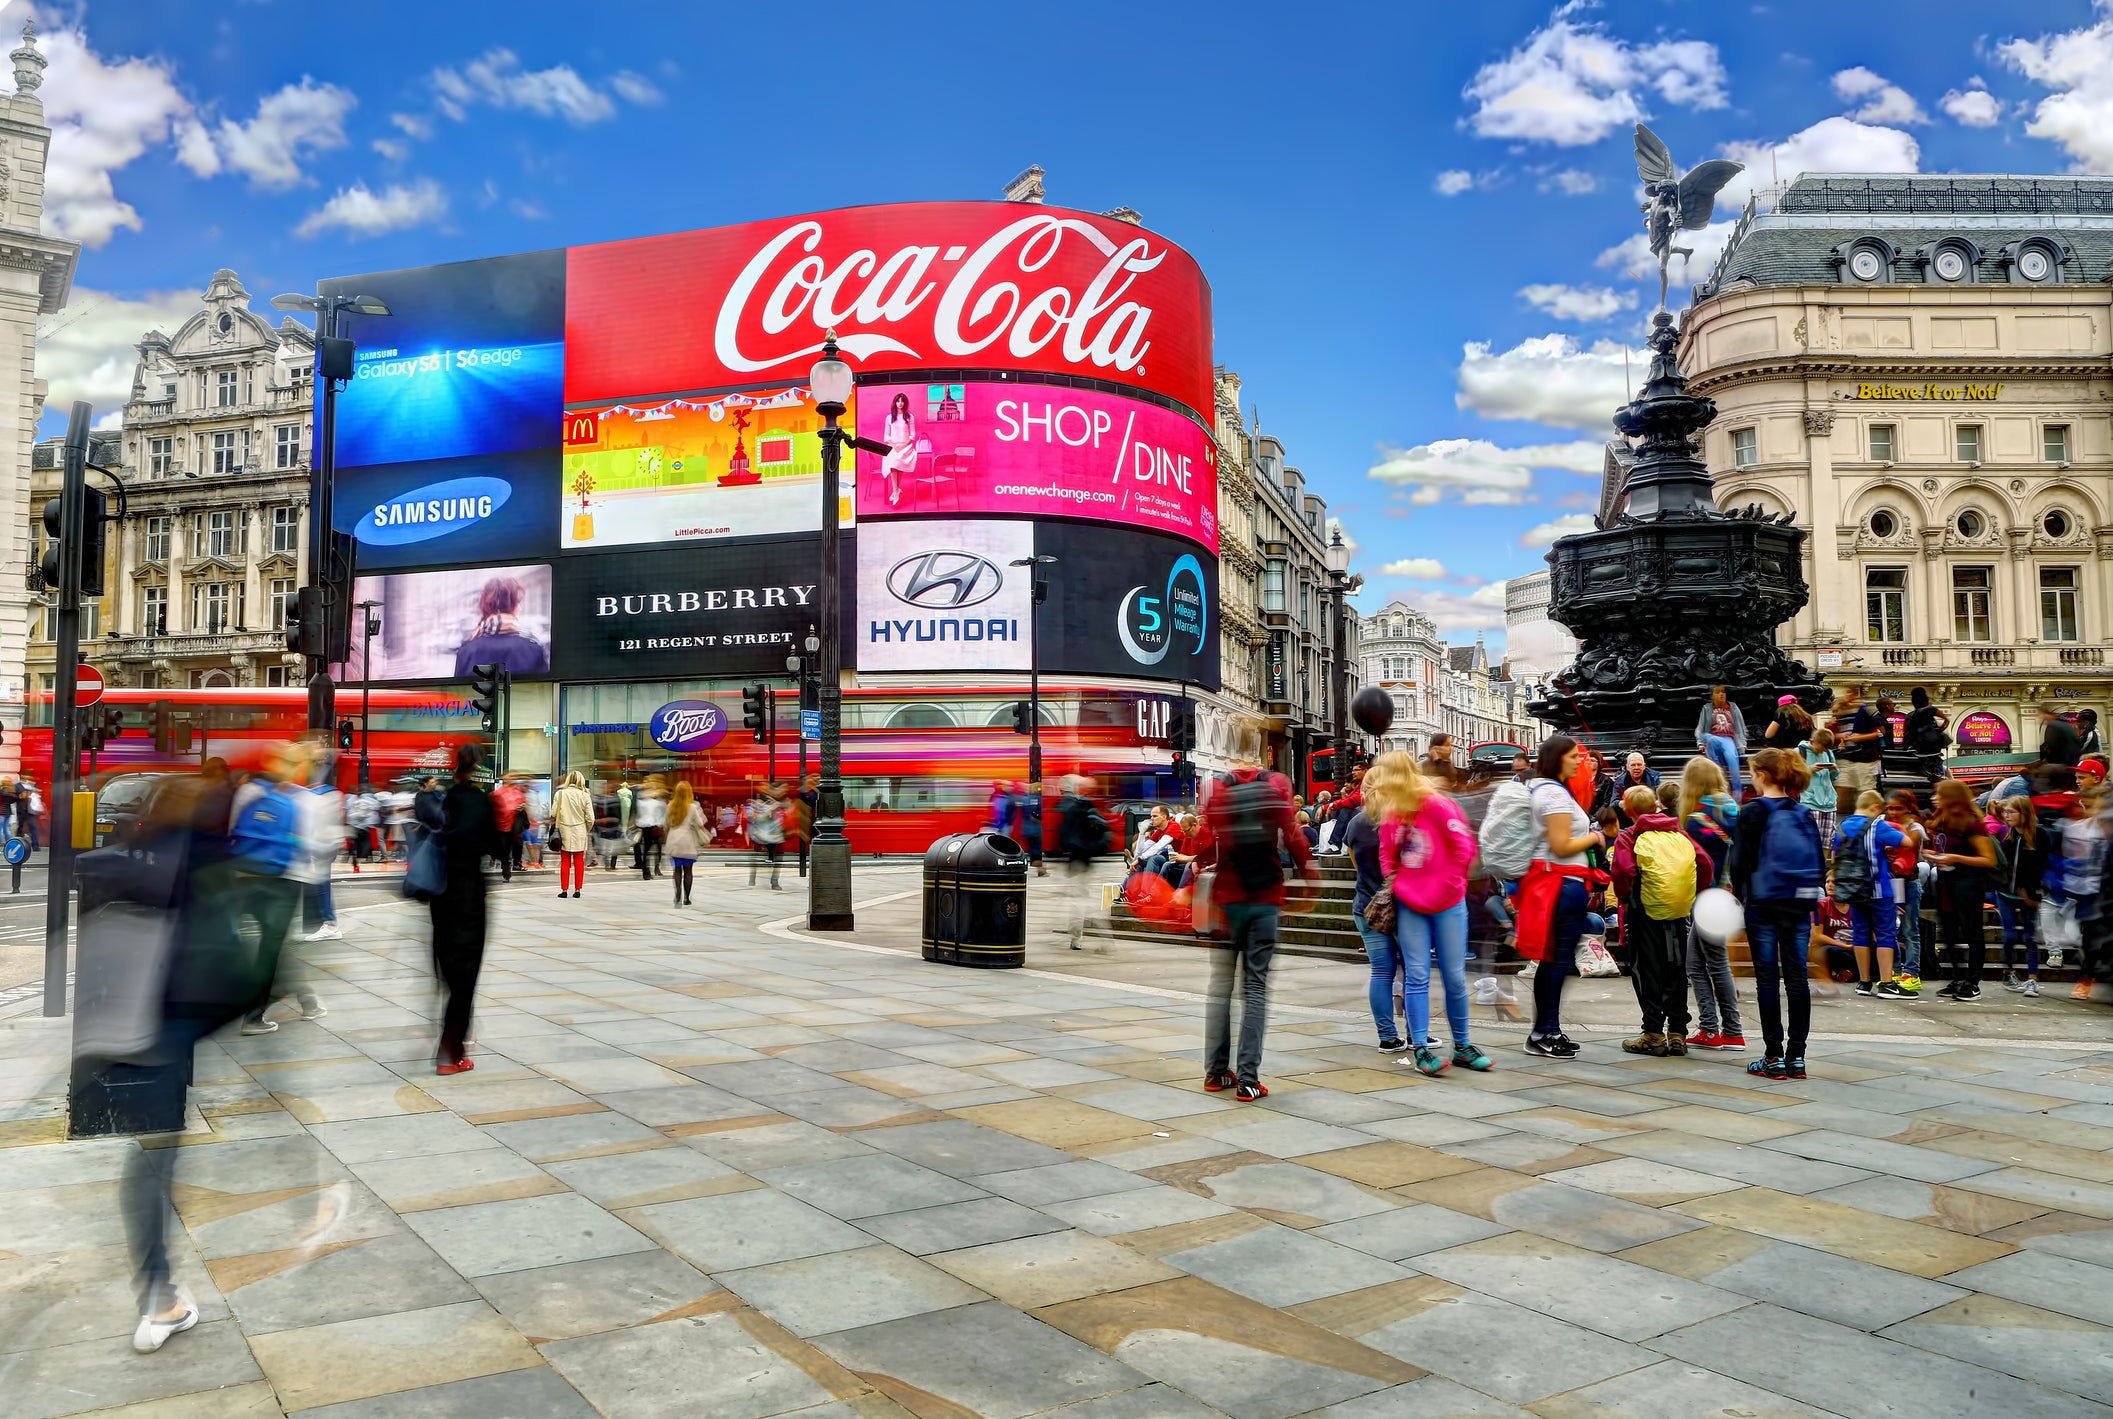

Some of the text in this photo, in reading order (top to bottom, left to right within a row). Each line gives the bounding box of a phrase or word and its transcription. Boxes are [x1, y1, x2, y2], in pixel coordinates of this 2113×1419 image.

[714, 215, 1168, 373] Coca-Cola
[357, 349, 522, 379] Galaxy S6 S6 edge
[359, 349, 398, 361] SAMSUNG
[1857, 382, 2003, 400] Believe It or Not!
[994, 400, 1112, 449] SHOP
[1134, 441, 1193, 495] DINE
[995, 482, 1116, 504] onenewchange.com
[374, 495, 492, 527] SAMSUNG
[674, 526, 731, 537] LittlePicca.com
[596, 585, 817, 617] BURBERRY
[1174, 603, 1197, 622] Mileage
[1138, 596, 1161, 632] 5
[870, 619, 1018, 643] HYUNDAI
[1139, 632, 1161, 643] YEAR
[1174, 618, 1200, 639] Warranty
[619, 632, 793, 650] 121 REGENT STREET
[409, 701, 485, 718] BARCLA
[1137, 699, 1170, 738] GAP
[572, 721, 639, 736] pharmacy
[656, 709, 717, 743] Boots
